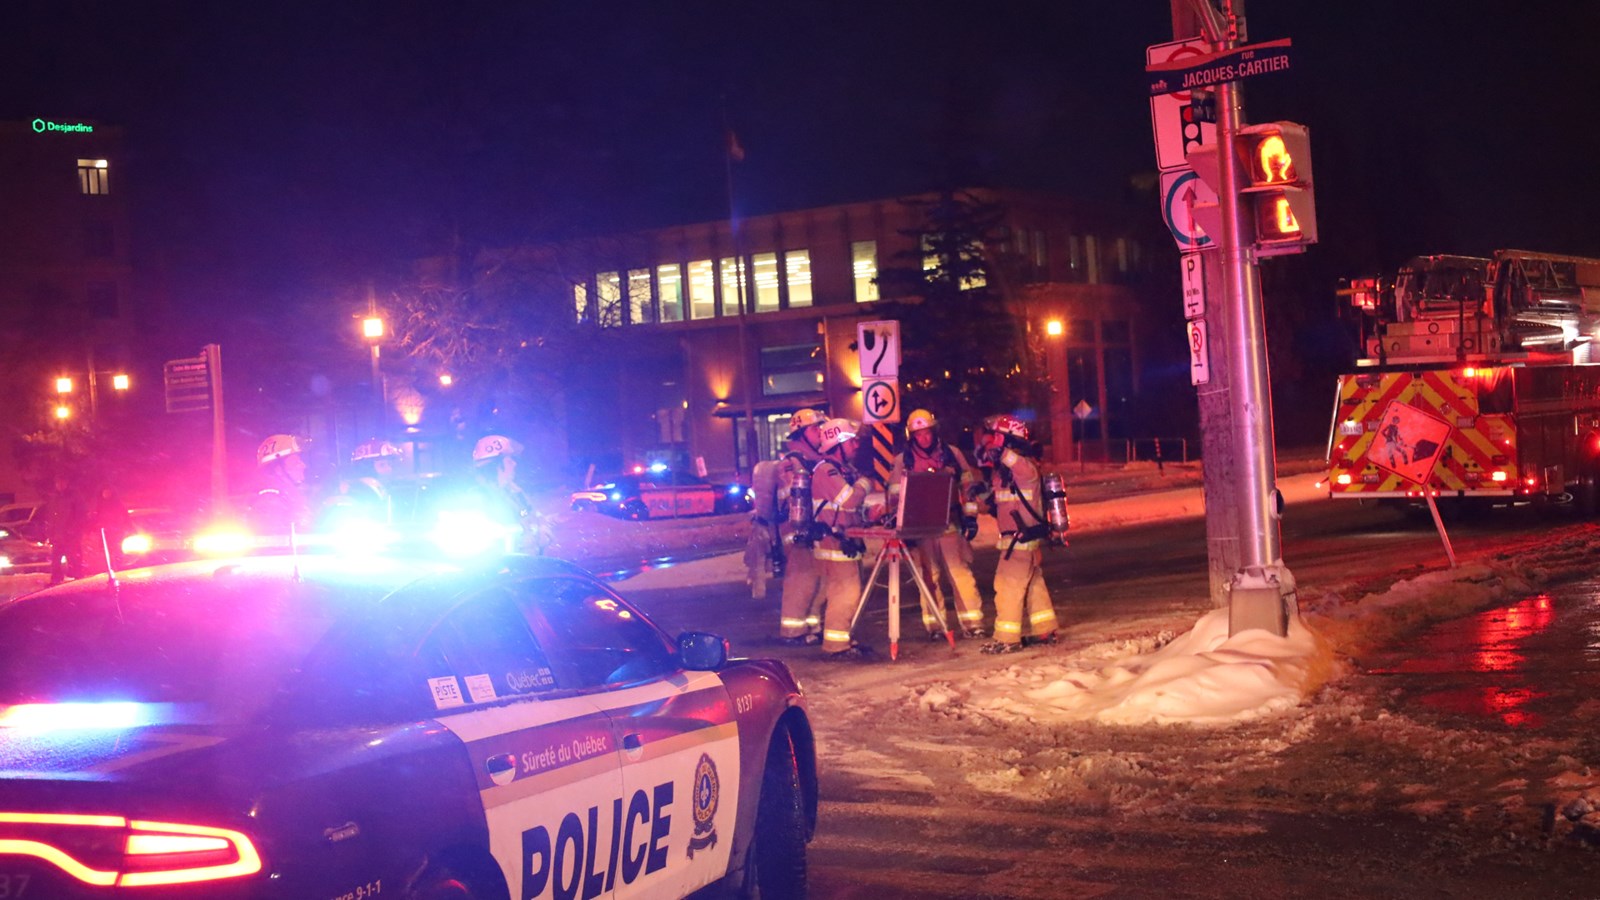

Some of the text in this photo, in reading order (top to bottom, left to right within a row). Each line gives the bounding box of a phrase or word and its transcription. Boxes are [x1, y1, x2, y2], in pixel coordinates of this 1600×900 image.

[1241, 50, 1254, 60] rue
[1182, 55, 1290, 88] JACQUES-CARTIER
[47, 121, 94, 134] Desjardins
[823, 426, 841, 440] 150
[263, 440, 277, 456] 27
[506, 670, 542, 693] Québec
[736, 693, 752, 714] 8137
[522, 736, 607, 773] Sûreté du Québec
[521, 780, 674, 900] POLICE
[357, 879, 380, 900] 9-1-1
